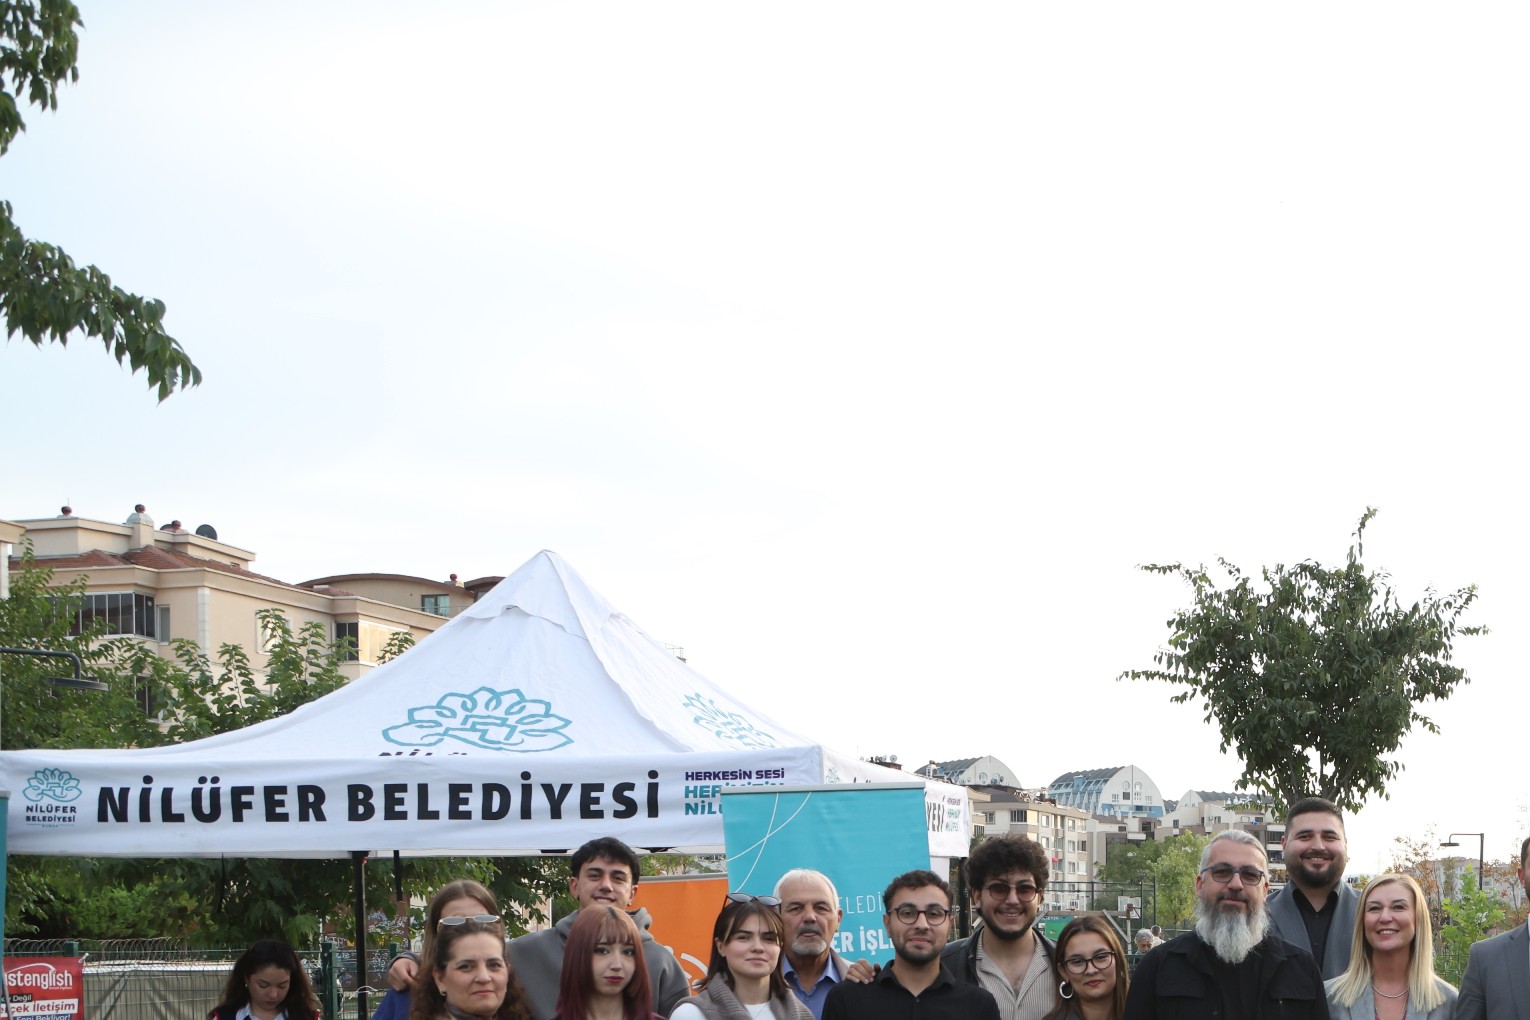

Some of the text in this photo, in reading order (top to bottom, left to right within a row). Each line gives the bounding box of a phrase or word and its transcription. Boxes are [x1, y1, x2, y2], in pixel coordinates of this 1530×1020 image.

[685, 768, 785, 781] HERKESİN SESİ
[97, 770, 659, 823] NİLÜFER BELEDİYESİ
[26, 803, 77, 814] NİLÜFER
[26, 815, 76, 823] BELEDİYESİ
